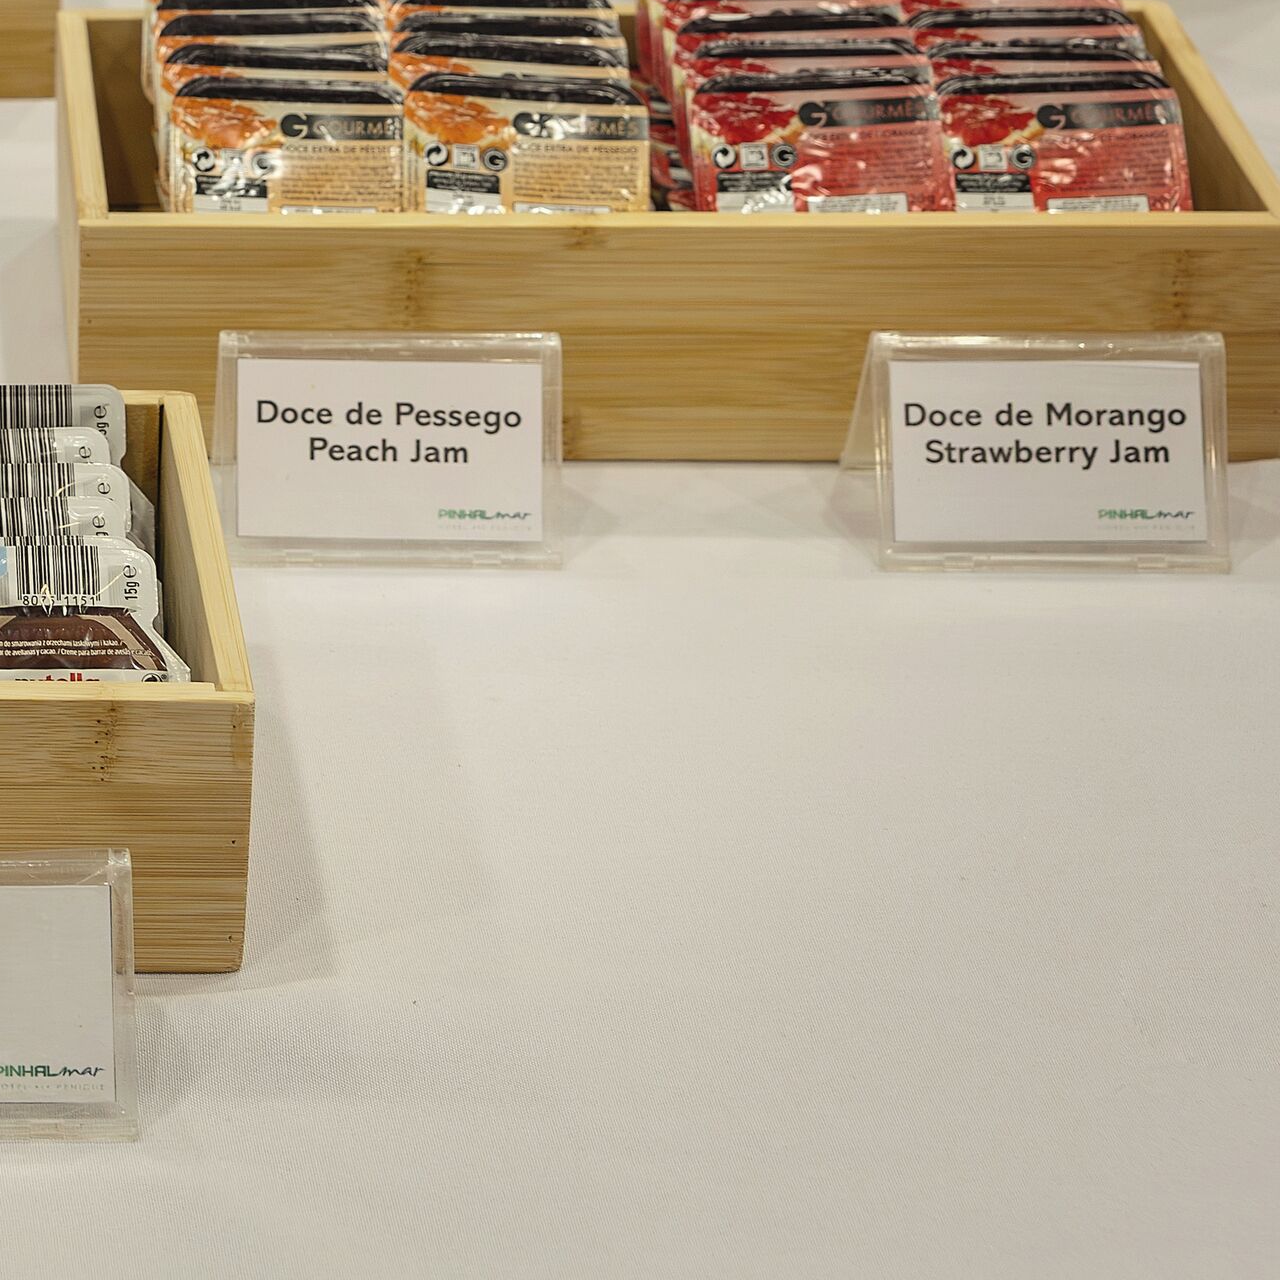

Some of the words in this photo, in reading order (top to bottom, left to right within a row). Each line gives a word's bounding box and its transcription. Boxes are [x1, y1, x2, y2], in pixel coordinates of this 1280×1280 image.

[256, 400, 332, 424] Doce
[345, 401, 382, 425] de
[396, 402, 522, 434] Pessego
[904, 402, 982, 426] Doce
[995, 402, 1032, 426] de
[1047, 402, 1187, 433] Morango
[309, 437, 398, 461] Peach
[410, 440, 469, 463] Jam
[925, 439, 1098, 470] Strawberry
[1110, 439, 1170, 463] Jam
[64, 595, 96, 606] 1151
[124, 581, 140, 601] 15g
